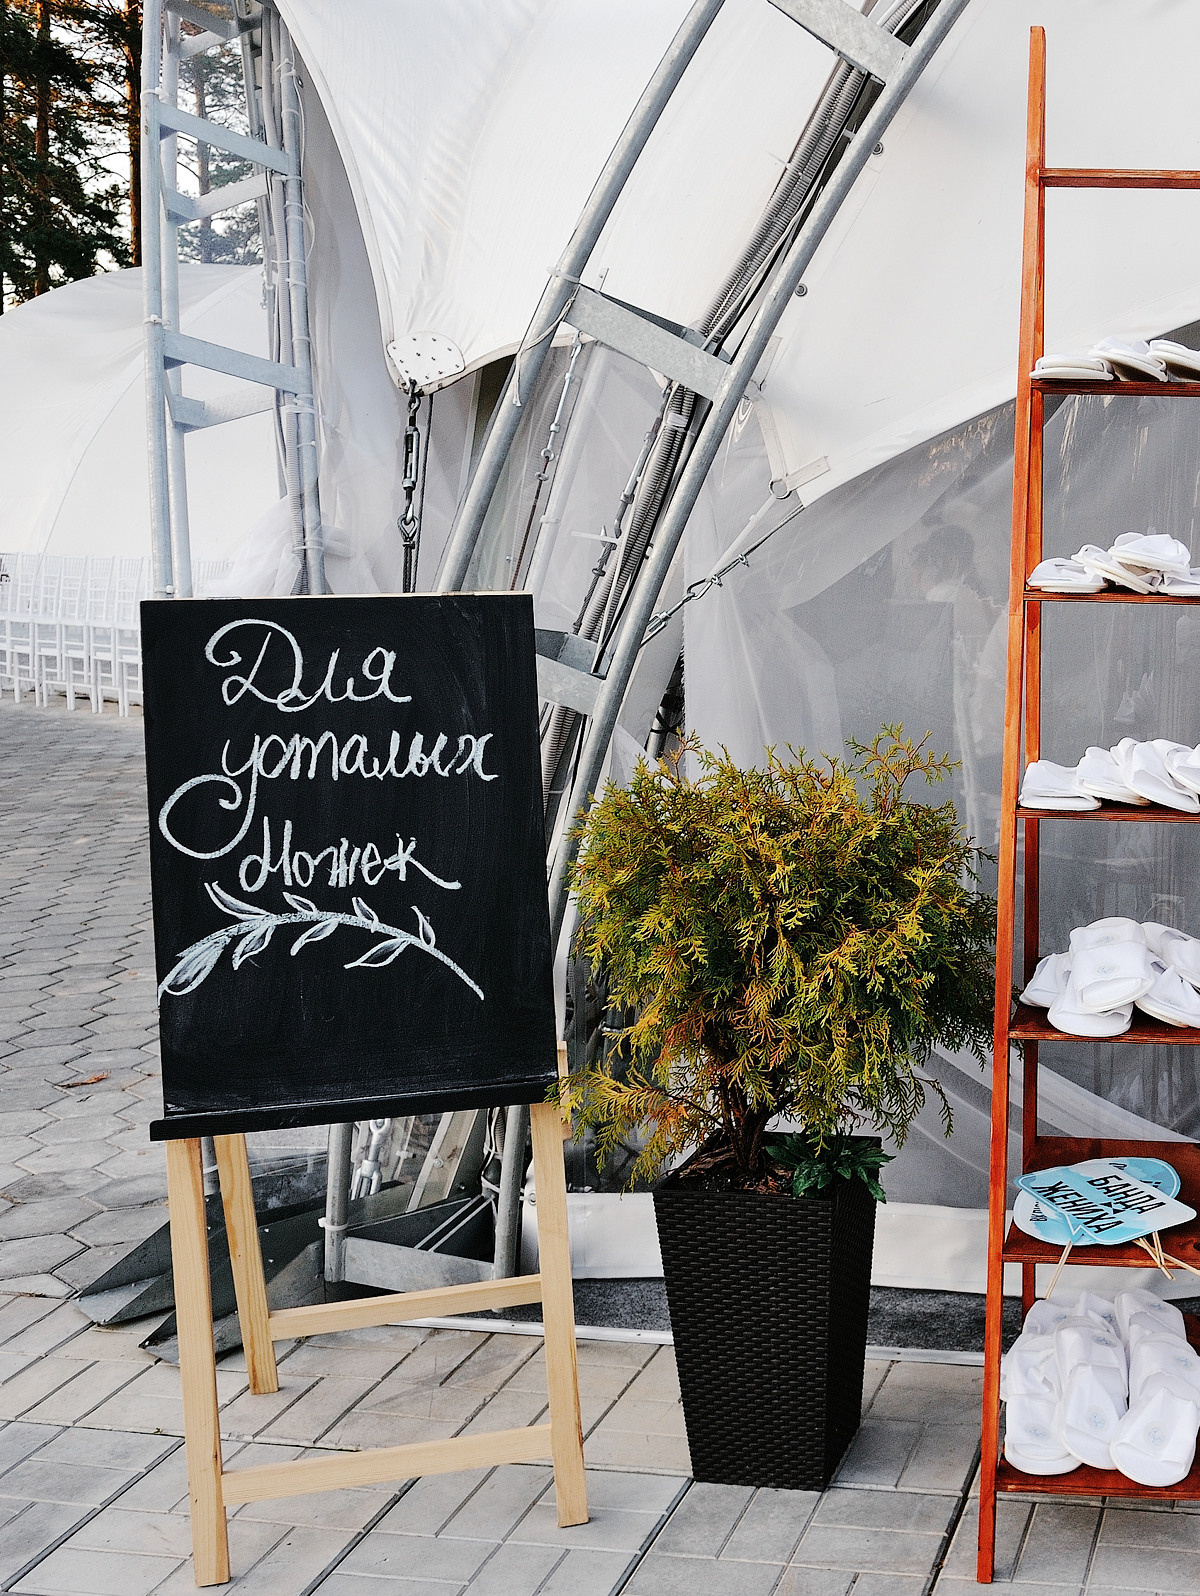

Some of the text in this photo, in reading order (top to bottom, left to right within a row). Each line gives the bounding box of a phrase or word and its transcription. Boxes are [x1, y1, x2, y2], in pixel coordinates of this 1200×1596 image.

[205, 618, 412, 713] Для
[1031, 1180, 1125, 1234] ЖЕНИХА
[1086, 1174, 1167, 1215] БАНДА
